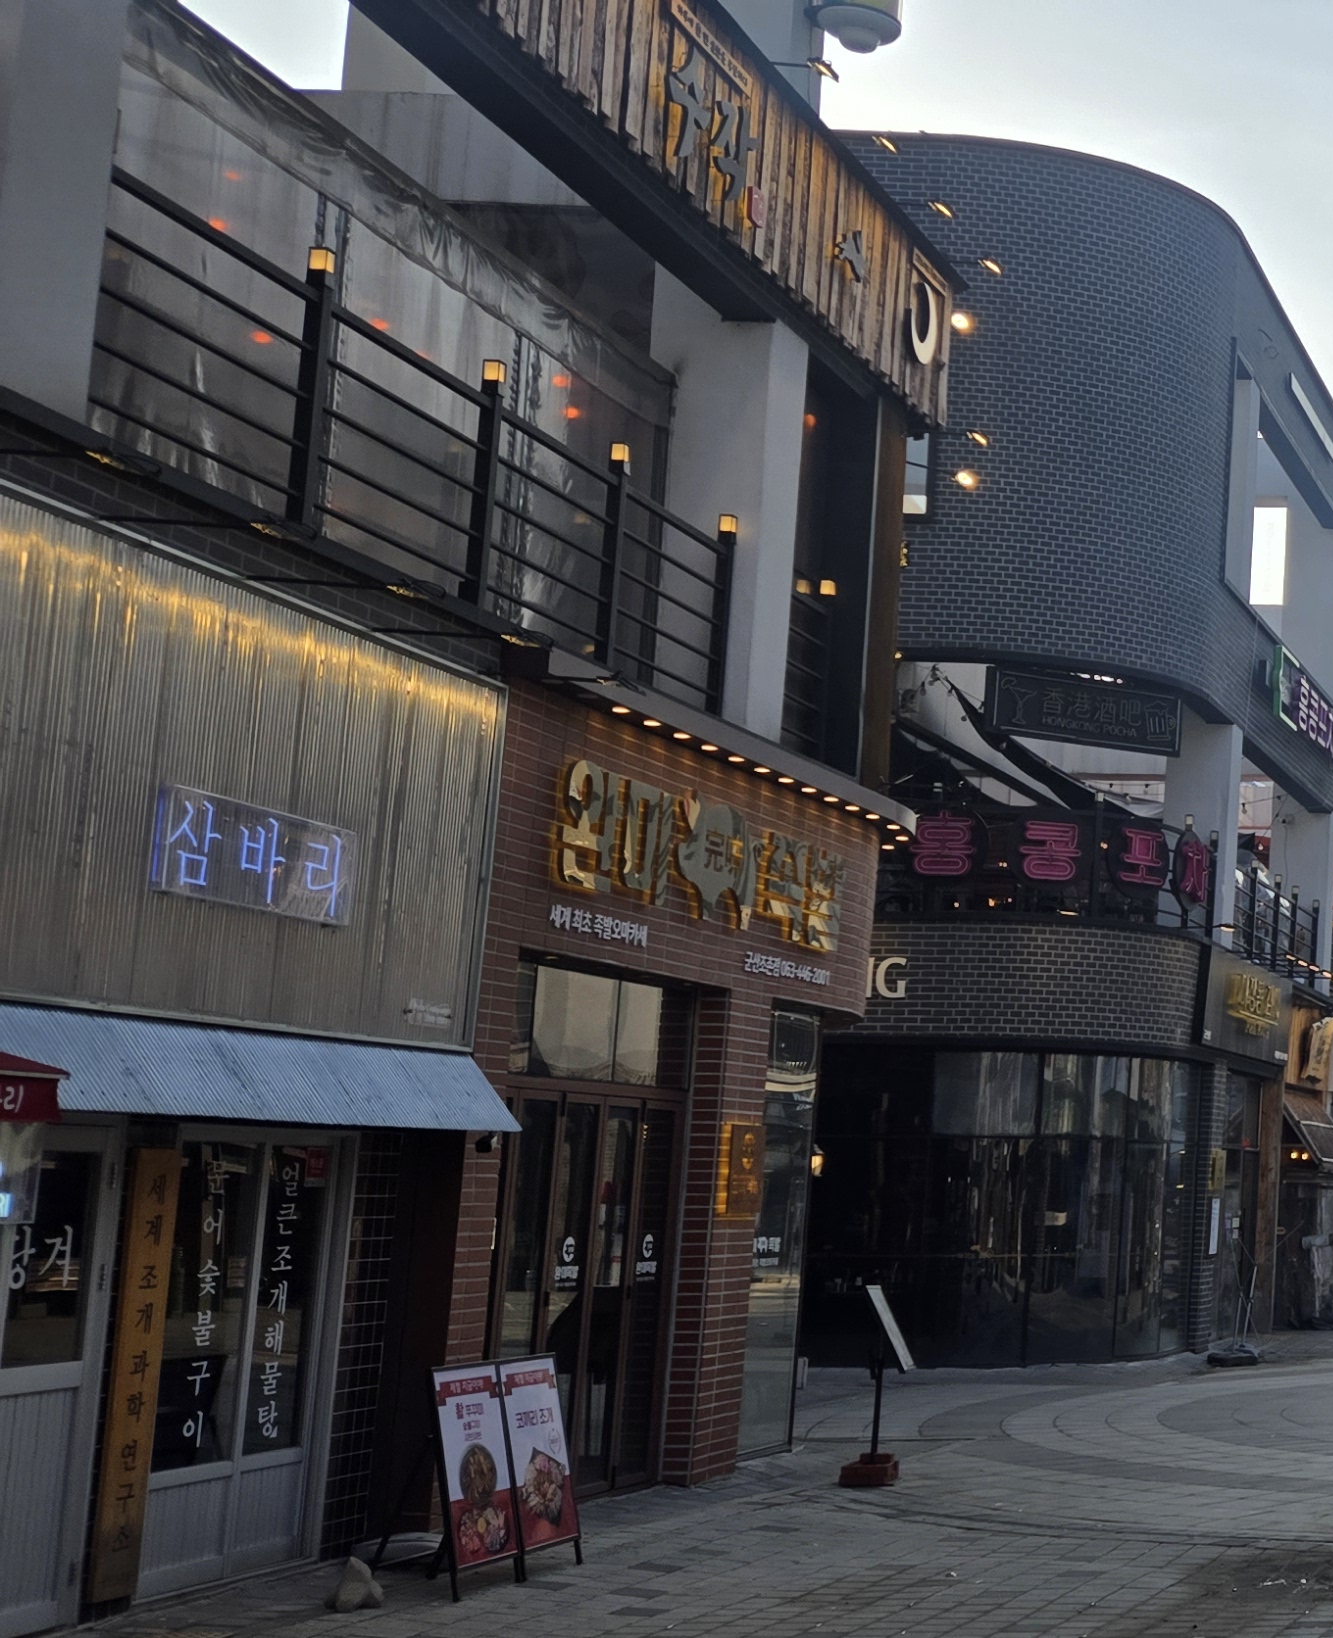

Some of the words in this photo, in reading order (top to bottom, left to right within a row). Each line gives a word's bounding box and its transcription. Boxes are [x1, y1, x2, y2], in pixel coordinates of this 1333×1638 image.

[1042, 687, 1142, 728] 香港酒吧
[1042, 715, 1099, 734] HONGKONG
[1101, 723, 1138, 739] POCHA
[167, 799, 345, 922] 삼바리
[910, 809, 1210, 905] 홍콩포차
[549, 902, 572, 930] 세계
[572, 907, 592, 933] 최초
[593, 913, 648, 947] 족발오마카세
